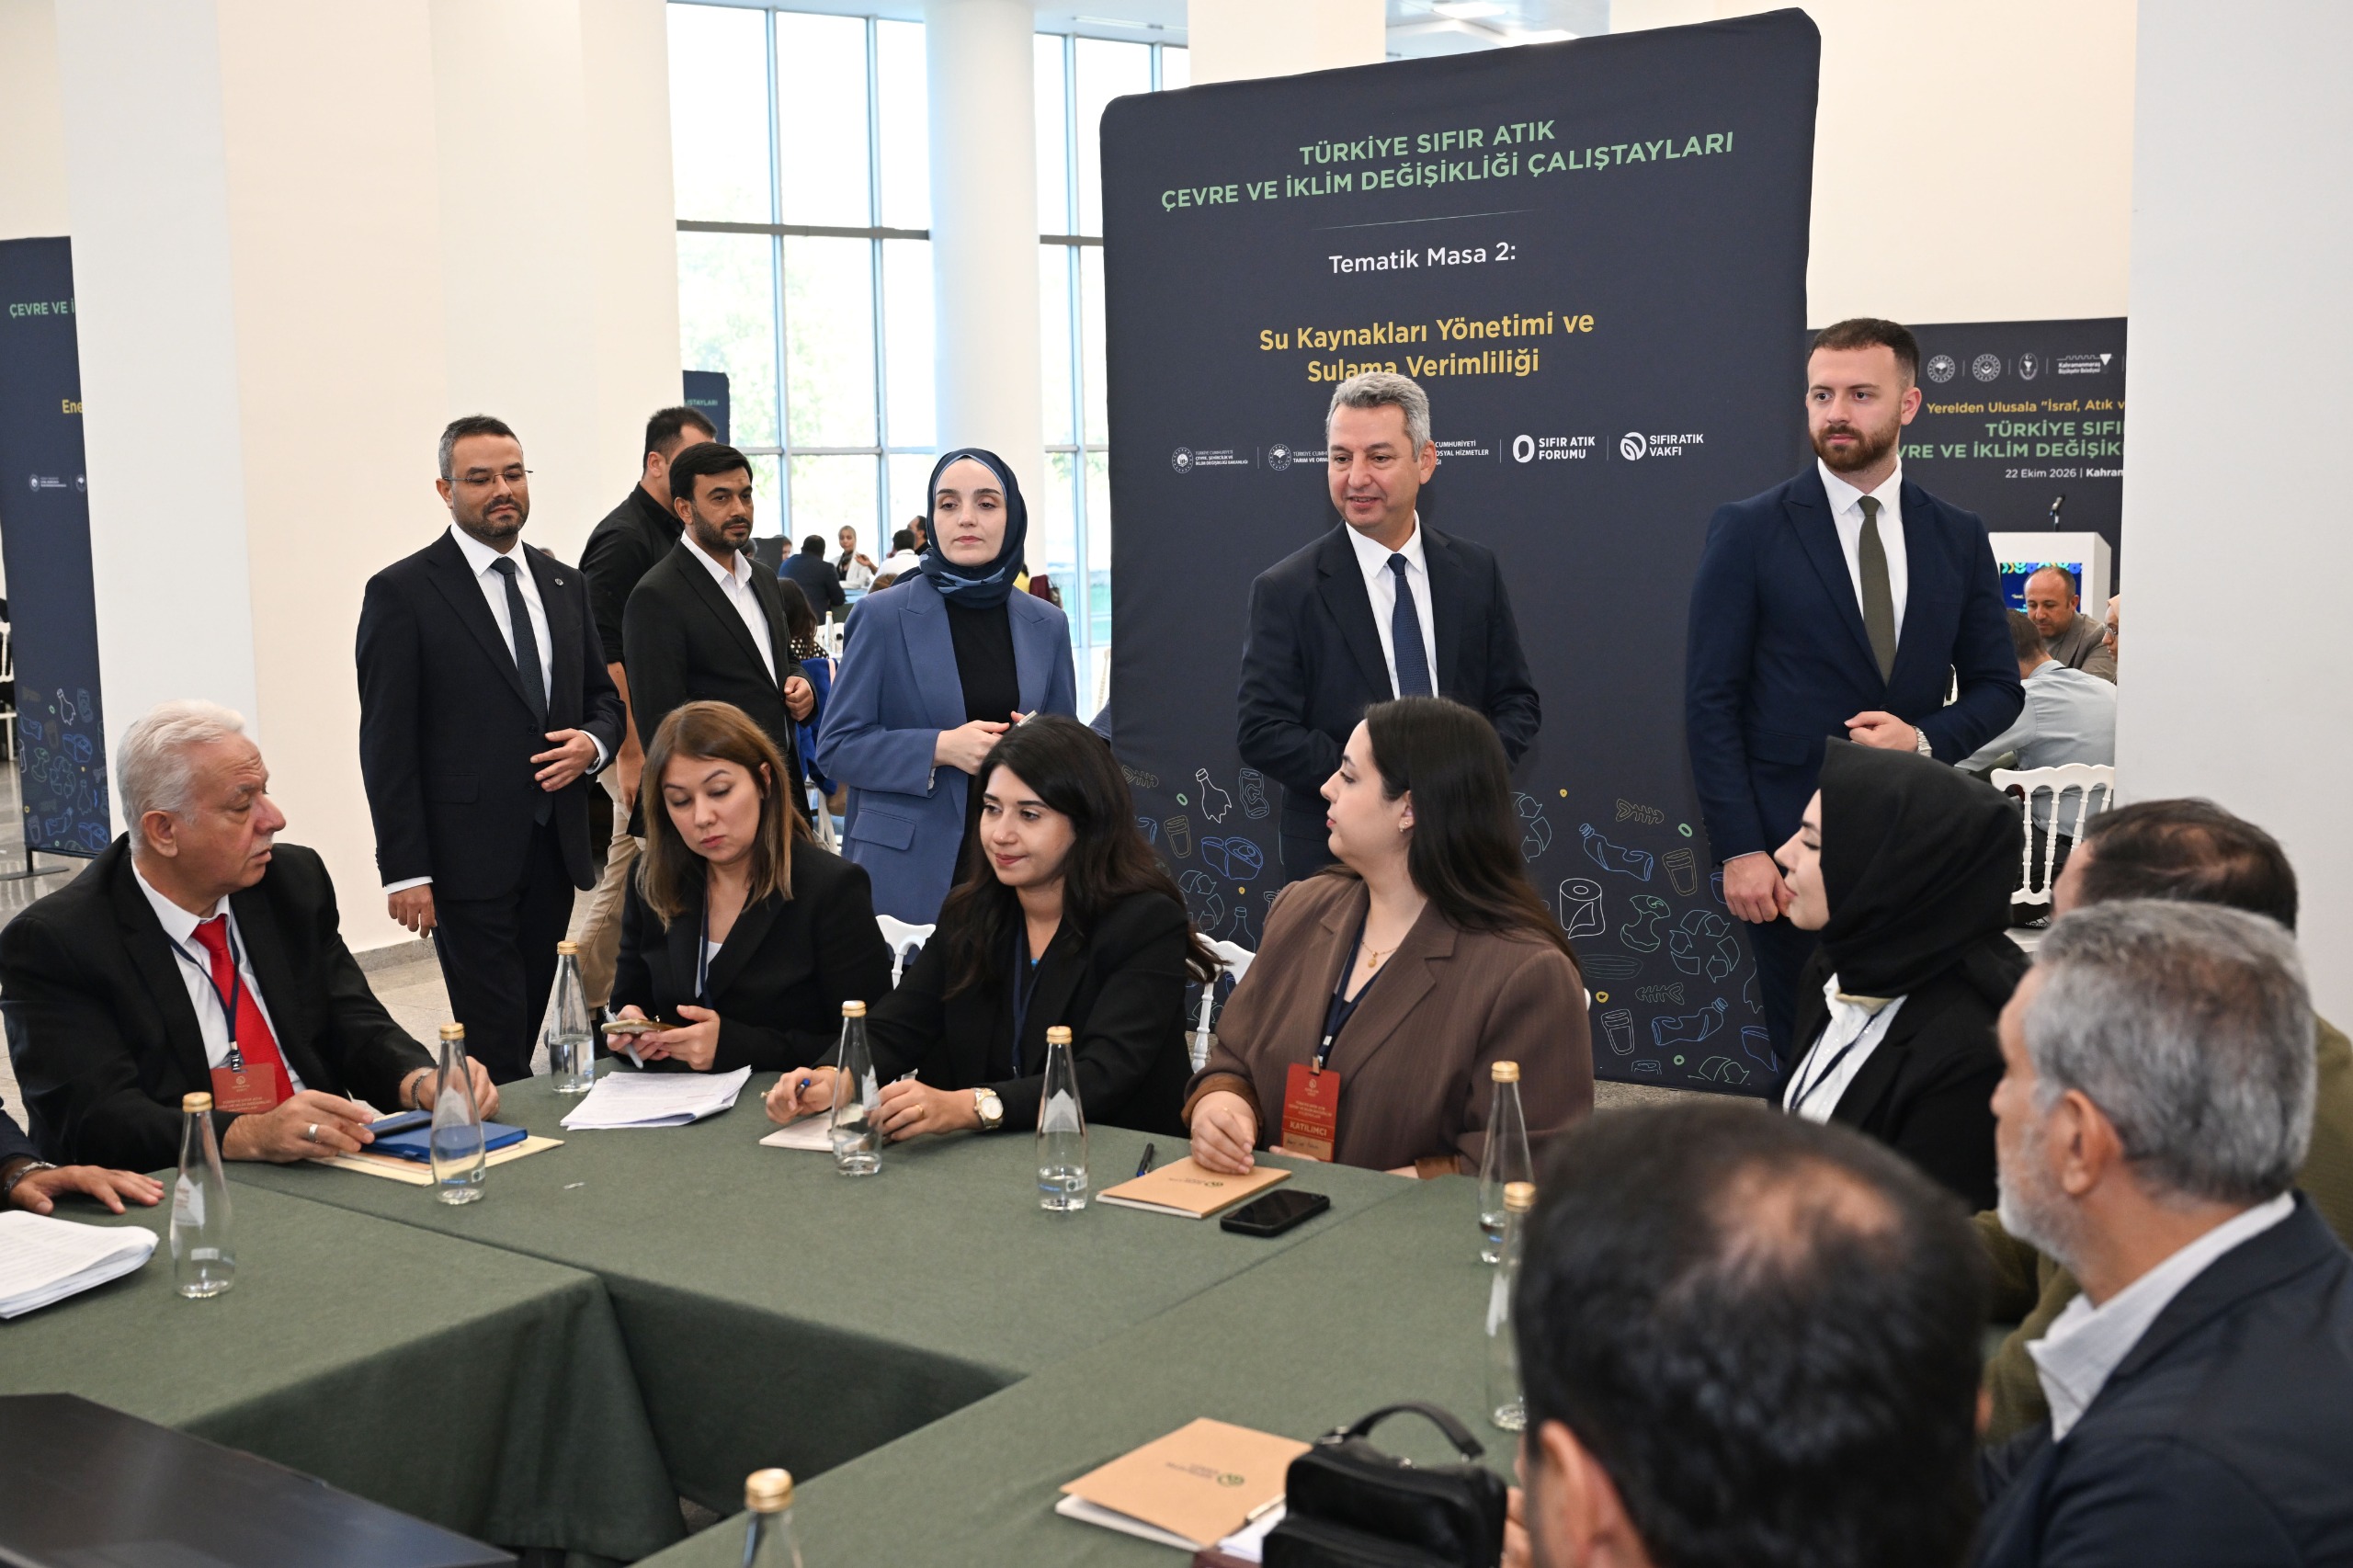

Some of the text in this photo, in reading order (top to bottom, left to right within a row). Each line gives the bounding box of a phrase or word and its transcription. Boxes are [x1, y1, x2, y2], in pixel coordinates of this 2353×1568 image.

[1300, 119, 1555, 165] TÜRKİYE SIFIR ATIK
[1161, 131, 1734, 212] ÇEVRE VE İKLİM DEĞİŞİKLİĞİ ÇALIŞTAYLARI
[1329, 243, 1517, 274] Tematik Masa 2:
[9, 302, 50, 319] ÇEVRE
[51, 301, 68, 314] VE
[1260, 312, 1595, 352] Su Kaynakları Yönetimi ve
[1307, 348, 1540, 382] Sulama Verimliliği
[62, 399, 83, 414] Ene
[1927, 403, 1984, 415] Yerelden
[1988, 401, 2037, 413] Ulusala
[2085, 399, 2113, 411] Atık
[2118, 401, 2125, 410] v
[1985, 420, 2124, 437] TÜRKİYE SIFI
[1435, 439, 1476, 449] CUMHURİYETİ
[1539, 436, 1596, 448] SIFIR ATIK
[1650, 433, 1704, 445] SIFIR ATIK
[1435, 449, 1489, 458] OSYAL HİZMETLER
[1539, 449, 1586, 460] FORUMU
[1649, 447, 1682, 457] VAKFI
[1897, 439, 2123, 459] VRE VE İKLİM DEĞİŞİK
[2005, 469, 2018, 479] 22
[2021, 468, 2047, 479] Ekim
[2050, 468, 2077, 479] 2026
